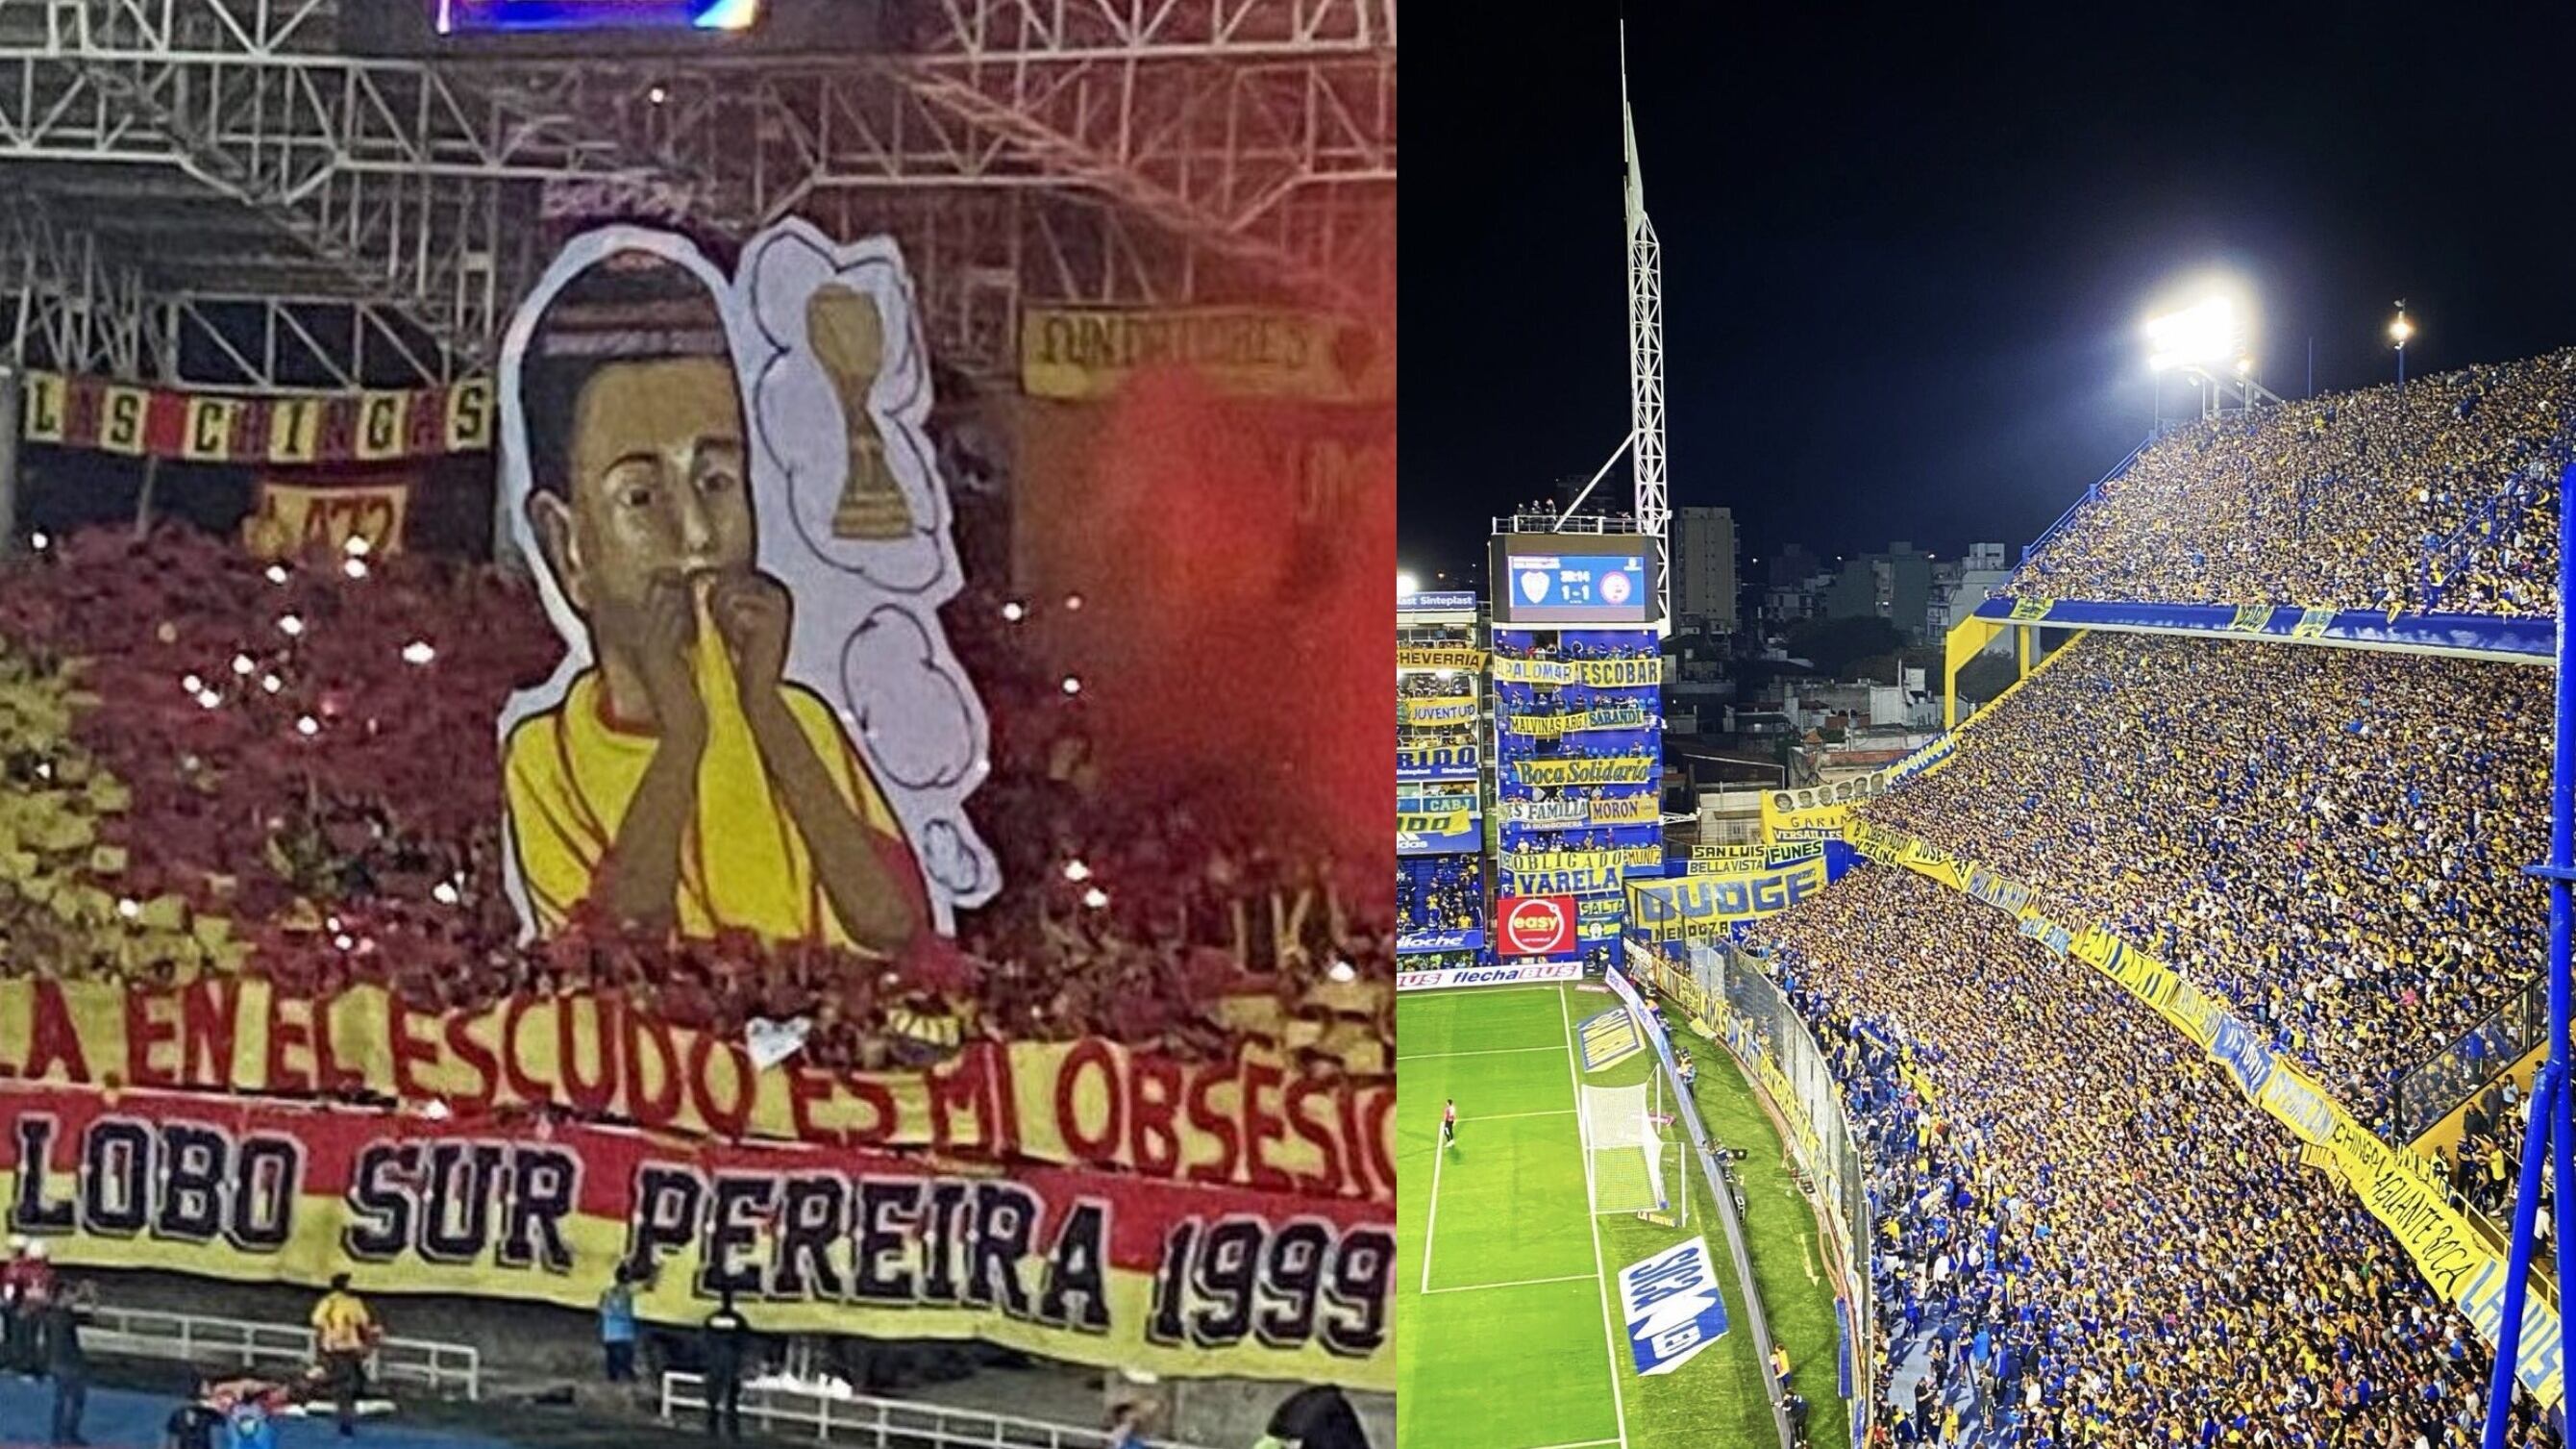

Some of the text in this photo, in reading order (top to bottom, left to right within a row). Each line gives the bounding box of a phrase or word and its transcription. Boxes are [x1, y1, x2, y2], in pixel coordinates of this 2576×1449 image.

[1420, 596, 1473, 606] Sinteplast
[1397, 652, 1479, 667] HEVERRIA
[1581, 662, 1657, 685] ESCOBAR
[1414, 704, 1475, 719] JUVENTUD
[1512, 718, 1562, 733] MALVINAS
[1519, 760, 1648, 784] Boca Solidario
[1529, 801, 1586, 819] FAMILIA
[1593, 801, 1639, 819] MORON
[1775, 830, 1844, 840] VERSAILLES
[1694, 845, 1765, 858] SAN LUIS
[1771, 841, 1822, 862] FUNES
[1514, 852, 1622, 870] OBLIGADO
[1519, 867, 1620, 894] VARELA
[1639, 867, 1817, 922] BUDGE
[1514, 915, 1558, 930] easy
[125, 977, 239, 1088] EN
[267, 983, 352, 1095] EL
[389, 987, 755, 1139] ESCUDO
[788, 1054, 899, 1148] ES
[929, 1035, 1020, 1155] MI
[10, 1113, 1396, 1359] LOBO SUR PEREIRA 1999
[2370, 1170, 2443, 1245] AGUANTE
[2426, 1225, 2478, 1294] BOCA
